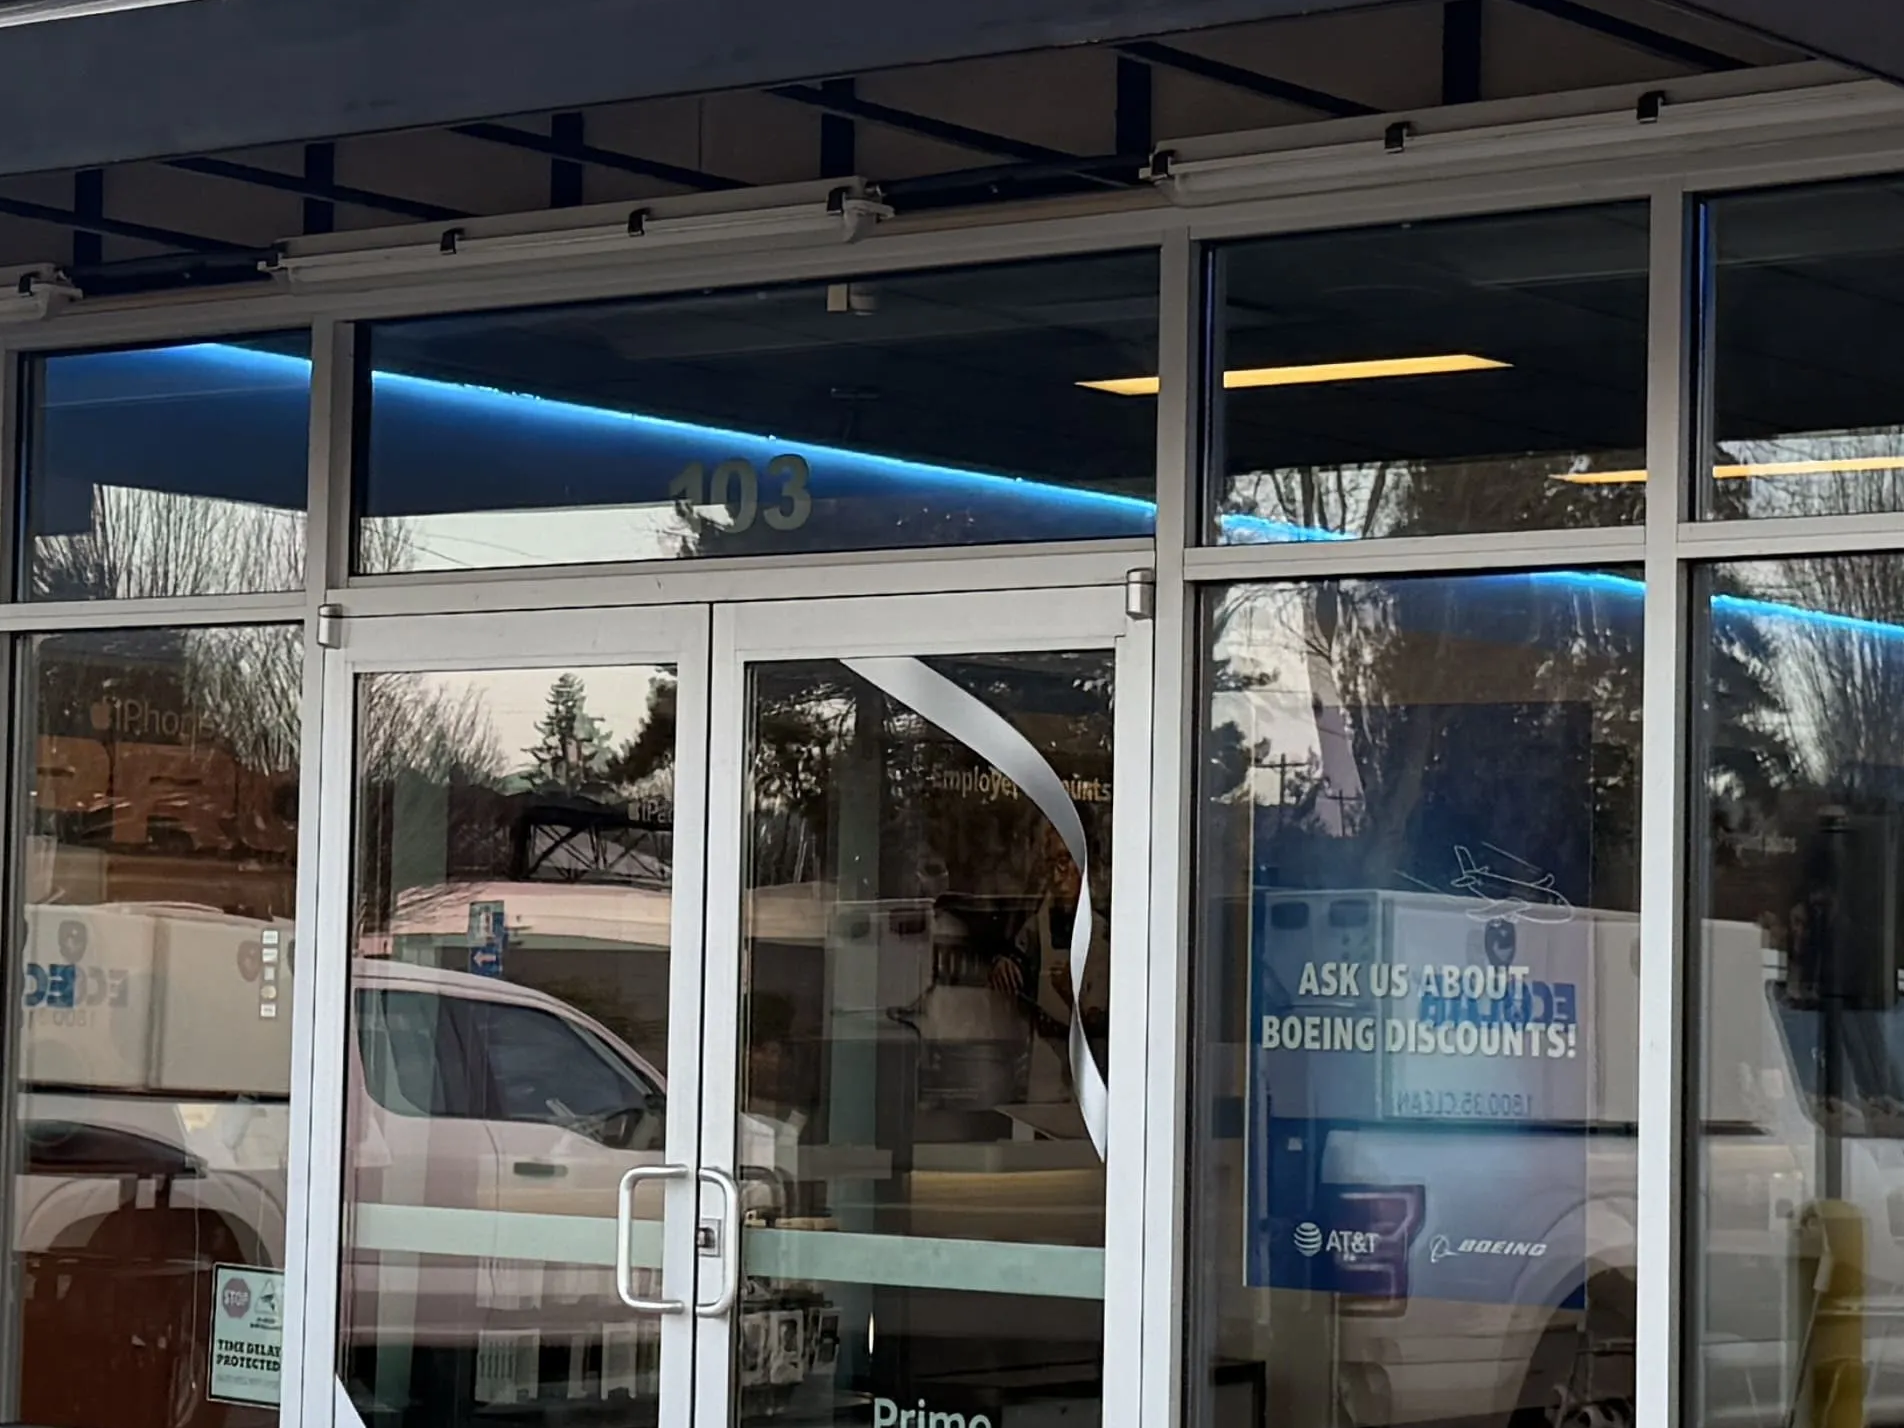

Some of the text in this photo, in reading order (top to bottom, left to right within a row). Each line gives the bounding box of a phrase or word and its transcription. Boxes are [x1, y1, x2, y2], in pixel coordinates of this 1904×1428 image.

[1299, 961, 1530, 1000] ASK US ABOUT
[1261, 1015, 1577, 1059] BOEING DISCOUNTS!
[1326, 1230, 1548, 1257] AT&T BOEING
[216, 1352, 282, 1373] PROTECTED
